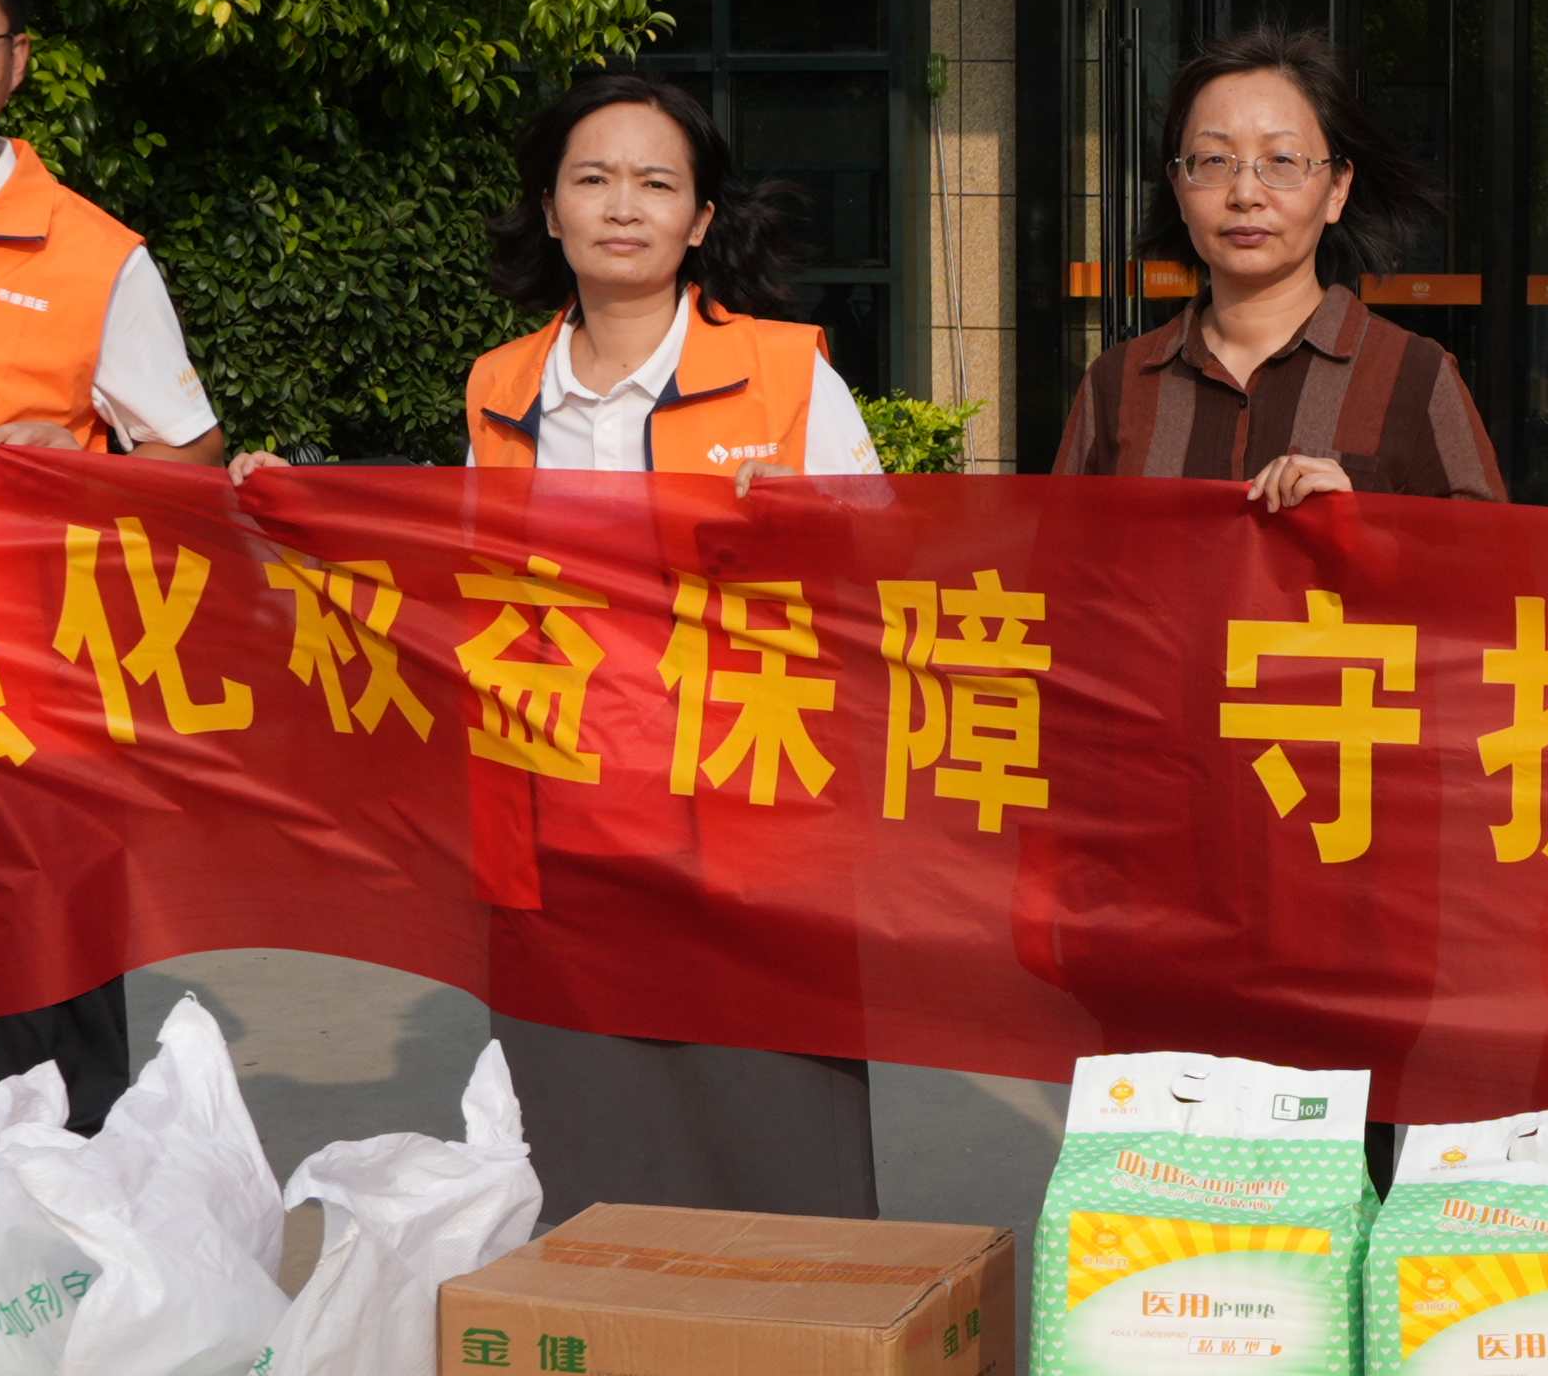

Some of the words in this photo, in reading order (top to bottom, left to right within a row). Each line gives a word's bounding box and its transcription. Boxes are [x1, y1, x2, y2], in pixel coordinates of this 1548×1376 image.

[1141, 1290, 1275, 1318] 医用护理垫
[461, 1328, 588, 1374] 金健
